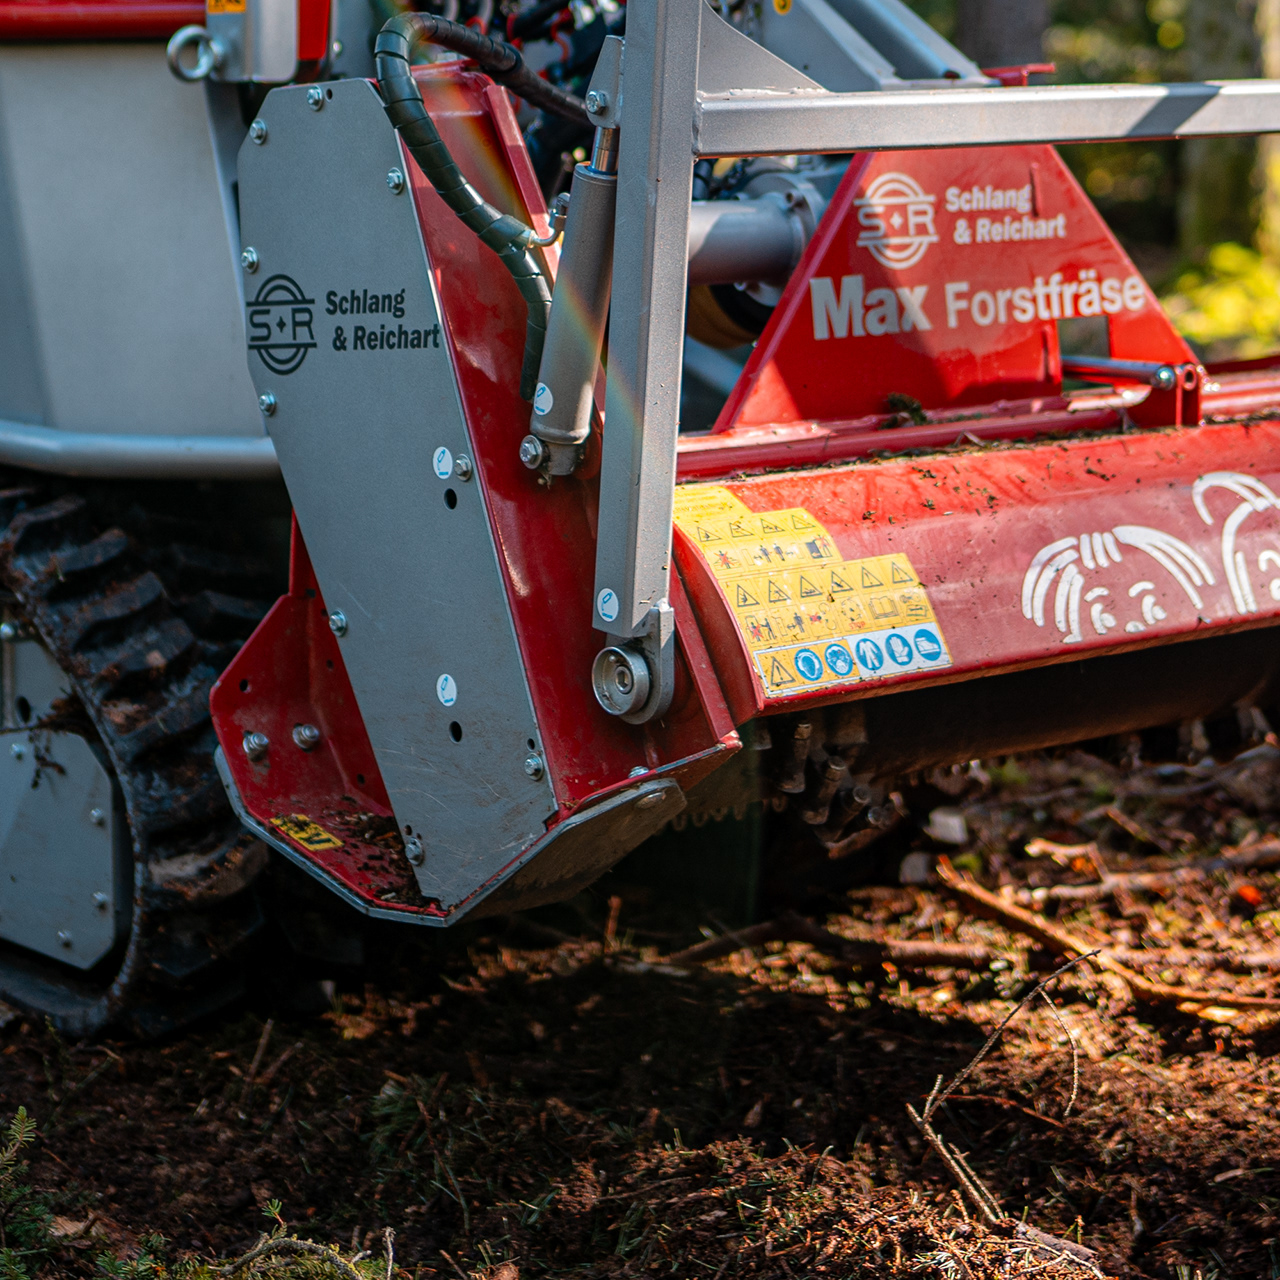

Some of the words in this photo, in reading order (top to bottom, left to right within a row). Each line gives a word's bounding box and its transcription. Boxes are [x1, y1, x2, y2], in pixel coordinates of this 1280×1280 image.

[945, 184, 1031, 213] Schlang
[953, 218, 971, 244] &
[975, 213, 1066, 243] Reichart
[325, 288, 406, 318] Schlang
[809, 275, 932, 341] Max
[945, 269, 1146, 328] Forstfräse
[332, 326, 347, 351] &
[353, 323, 440, 351] Reichart
